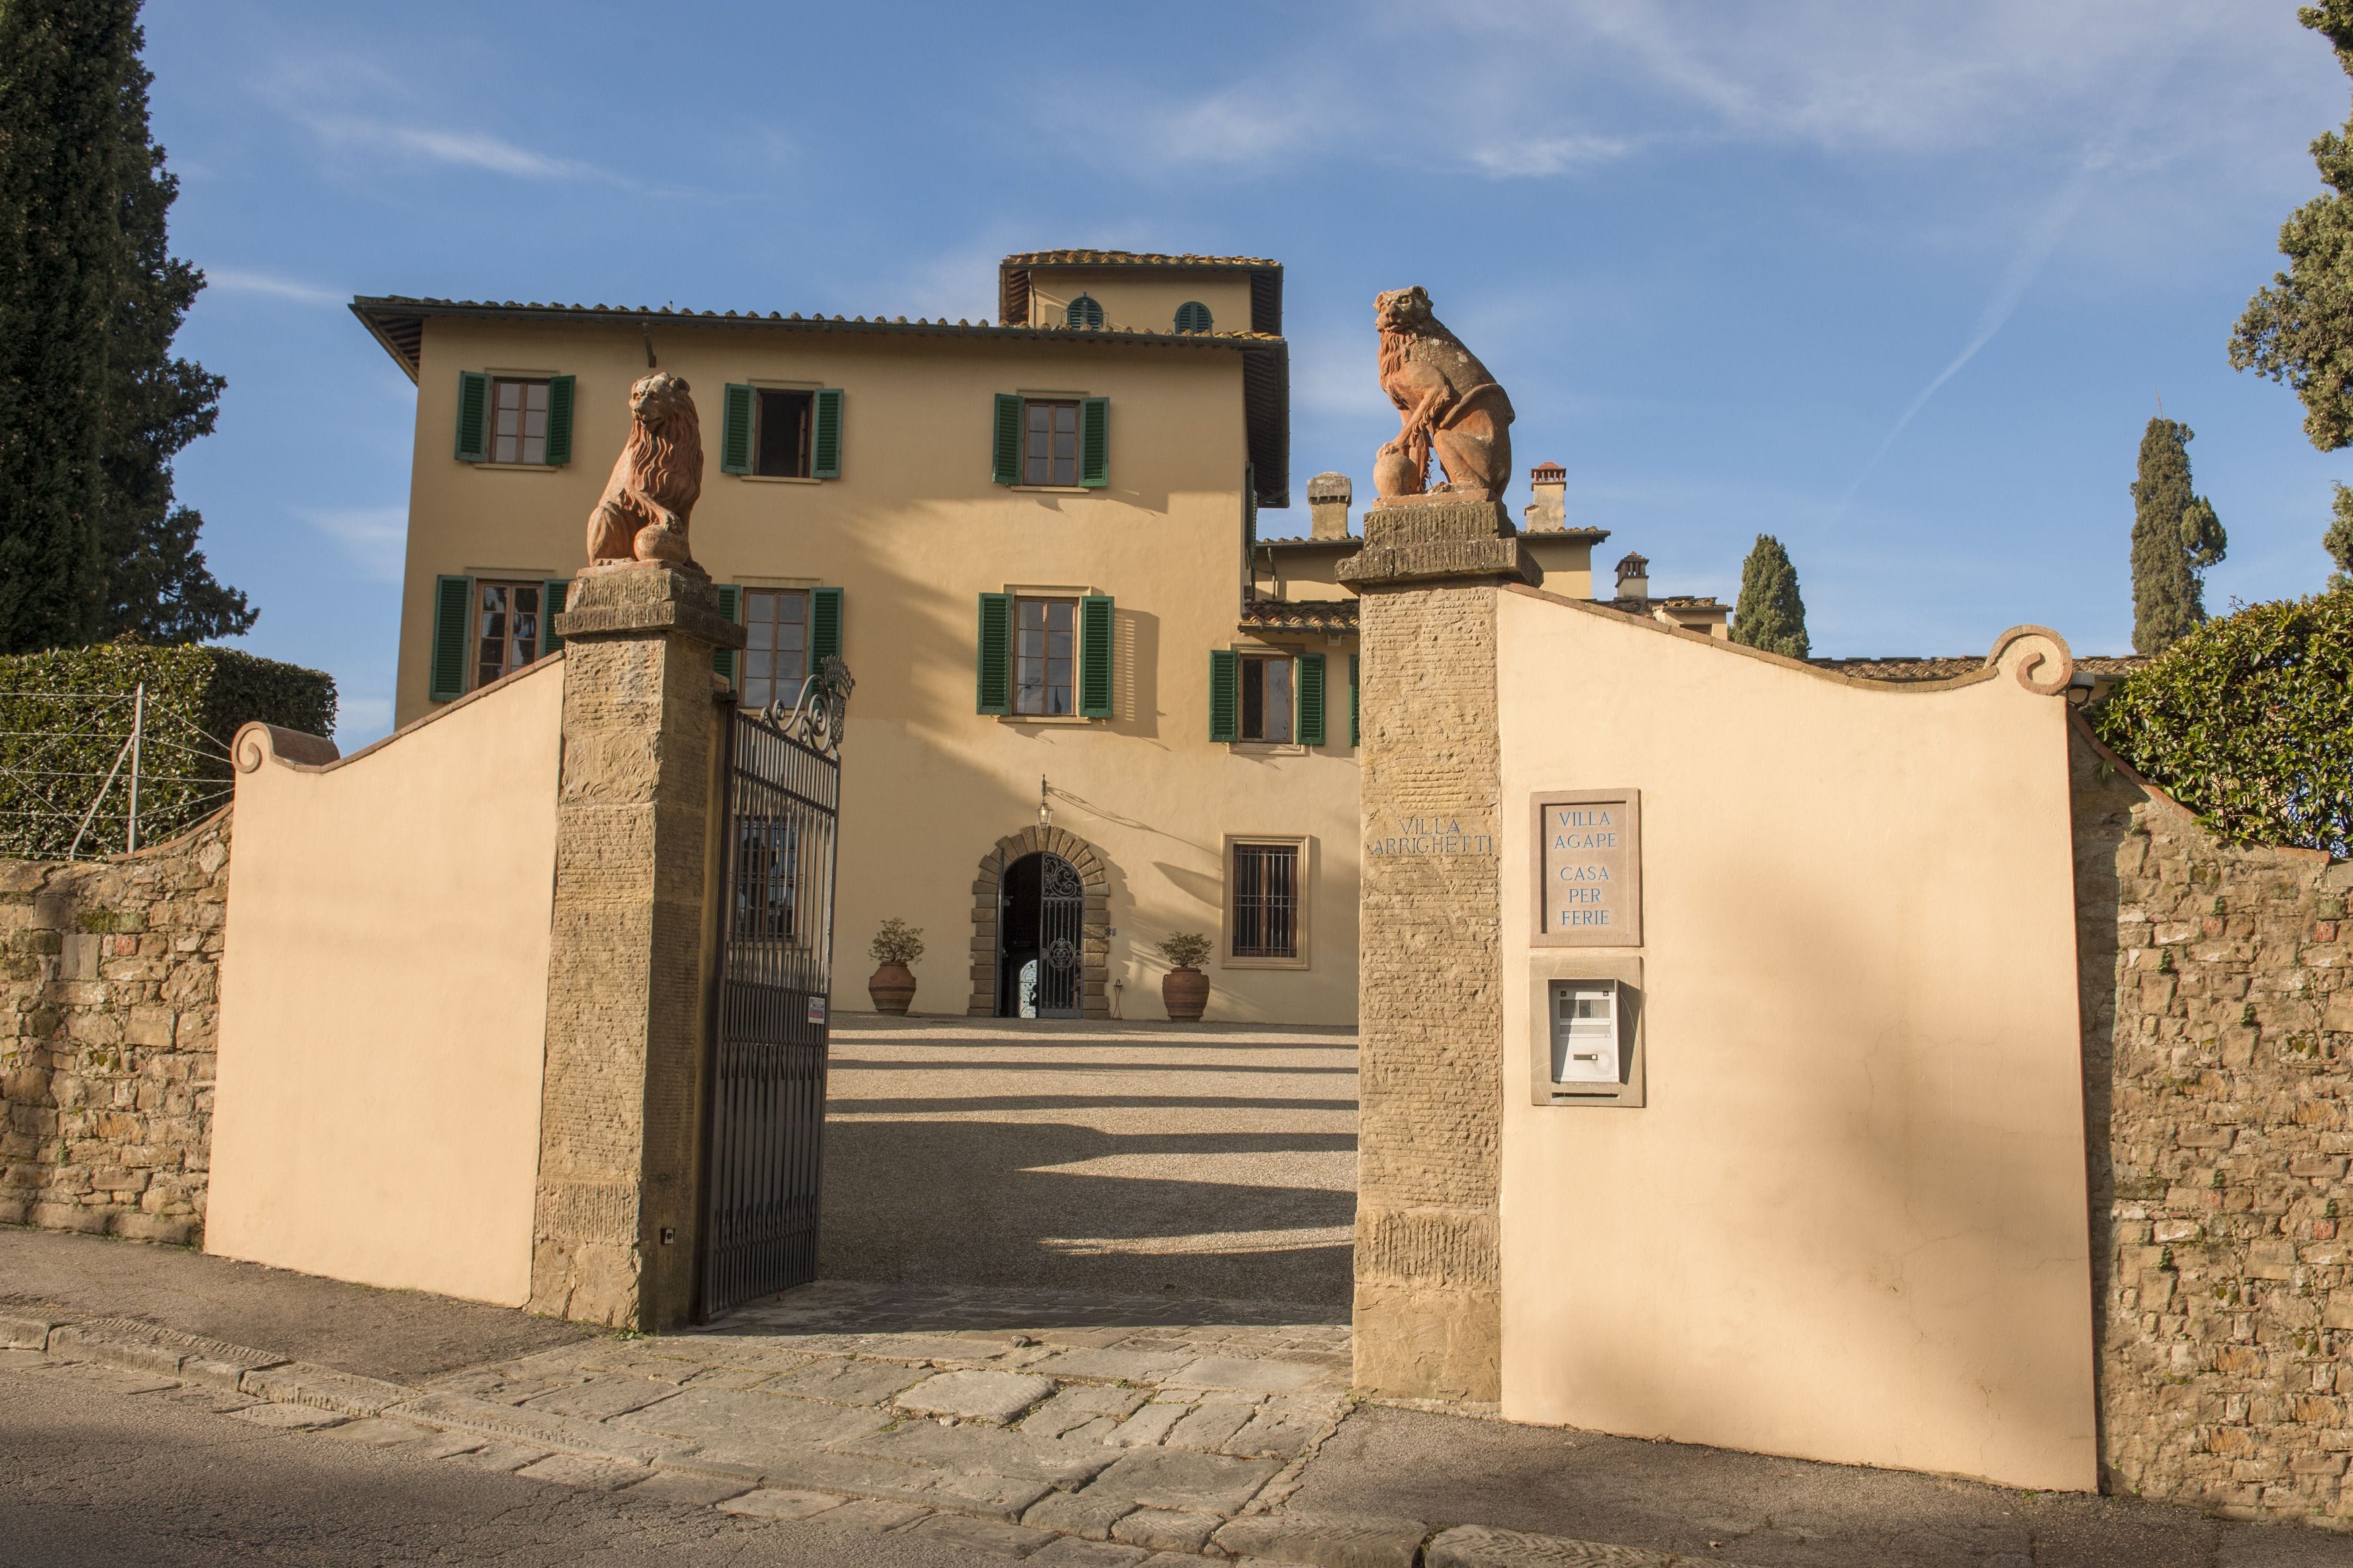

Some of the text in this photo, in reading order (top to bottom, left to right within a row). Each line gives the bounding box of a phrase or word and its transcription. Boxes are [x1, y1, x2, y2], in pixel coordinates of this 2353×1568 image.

[1399, 818, 1460, 835] VILLA
[1559, 811, 1611, 827] VILLA
[1373, 836, 1492, 854] ARRIGHETTI
[1554, 833, 1617, 849] AGAPE
[1560, 866, 1609, 881] CASA
[1569, 889, 1601, 903] PER
[1562, 910, 1609, 925] FERIE
